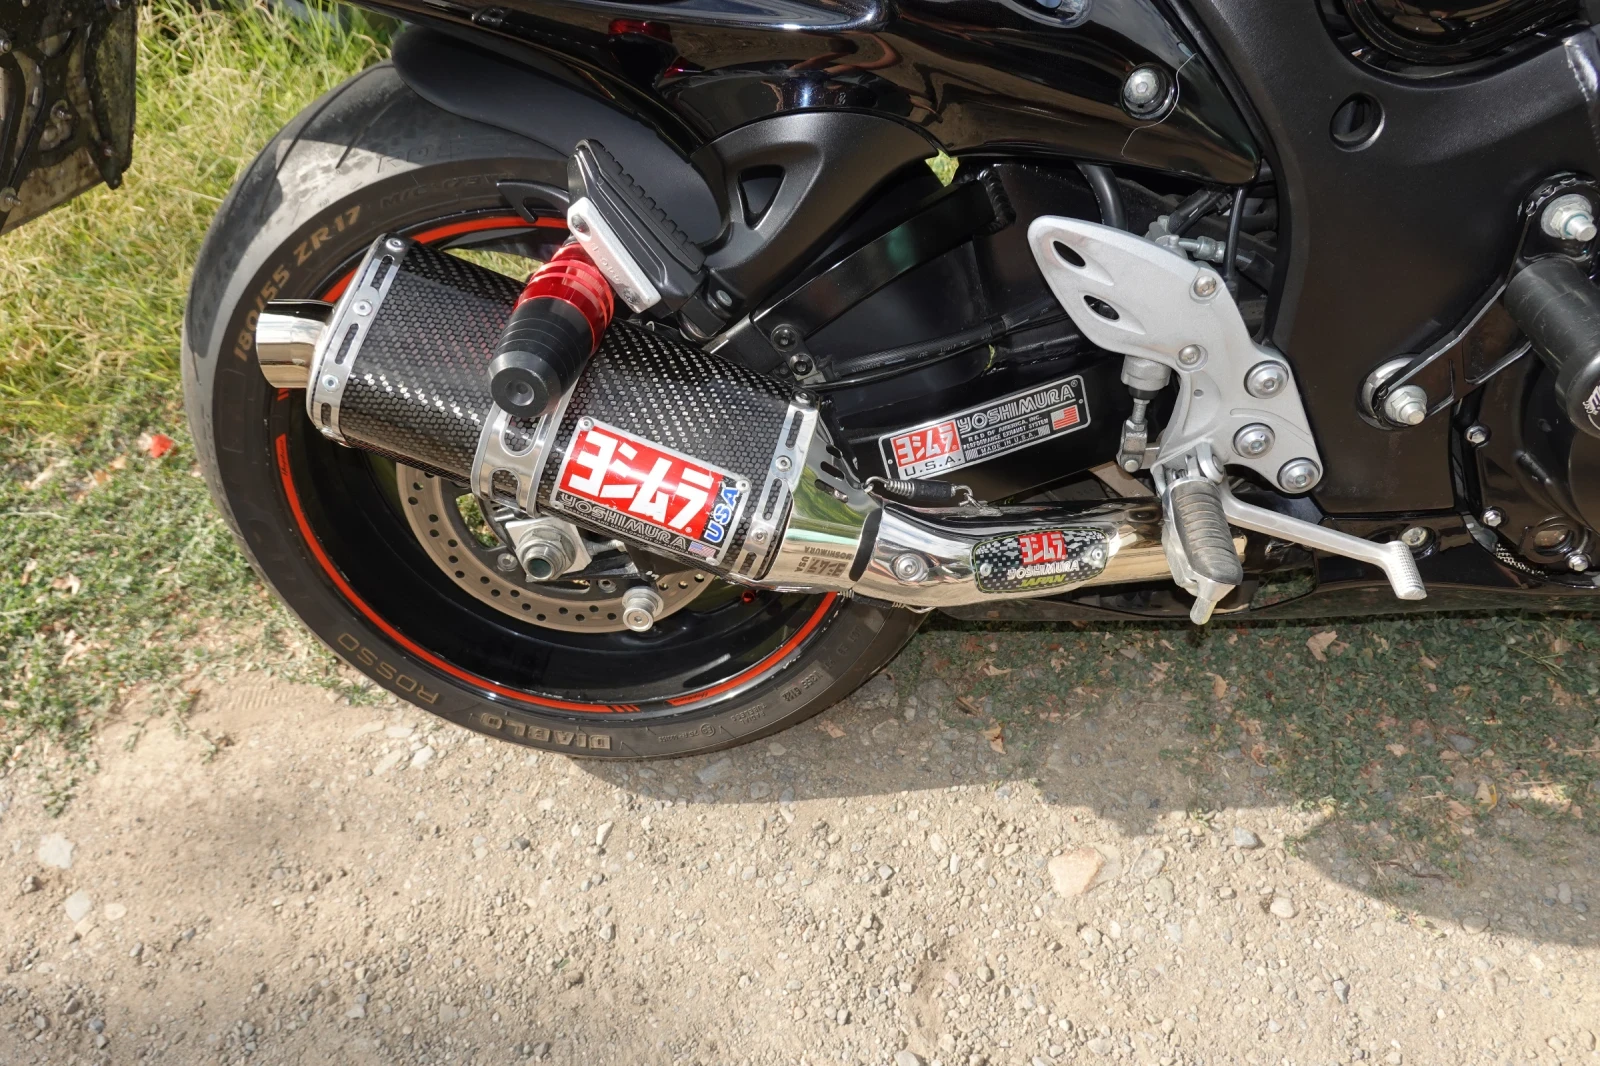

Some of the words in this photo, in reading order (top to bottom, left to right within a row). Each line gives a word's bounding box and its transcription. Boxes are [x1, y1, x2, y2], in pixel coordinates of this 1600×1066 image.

[233, 264, 290, 362] 180/55
[957, 385, 1075, 432] YOSHIMURA
[897, 425, 954, 465] ヨシムラ
[963, 435, 1001, 450] PERFORMANCE
[1003, 426, 1026, 437] EXHAUST
[1029, 419, 1049, 429] SYSTEM
[981, 444, 1002, 454] MADE
[568, 430, 715, 531] ヨシムラ
[904, 455, 962, 477] U.S.A.
[560, 493, 687, 549] YOSHIMURA
[704, 486, 740, 543] USA
[794, 556, 810, 572] USA
[804, 545, 854, 560] YOSHIMURA
[1020, 533, 1063, 563] ヨシムラ
[1007, 560, 1080, 581] YOSHIMURA
[1020, 574, 1066, 588] JAPAN
[336, 632, 442, 705] ROSSO
[480, 712, 613, 751] DIABLO
